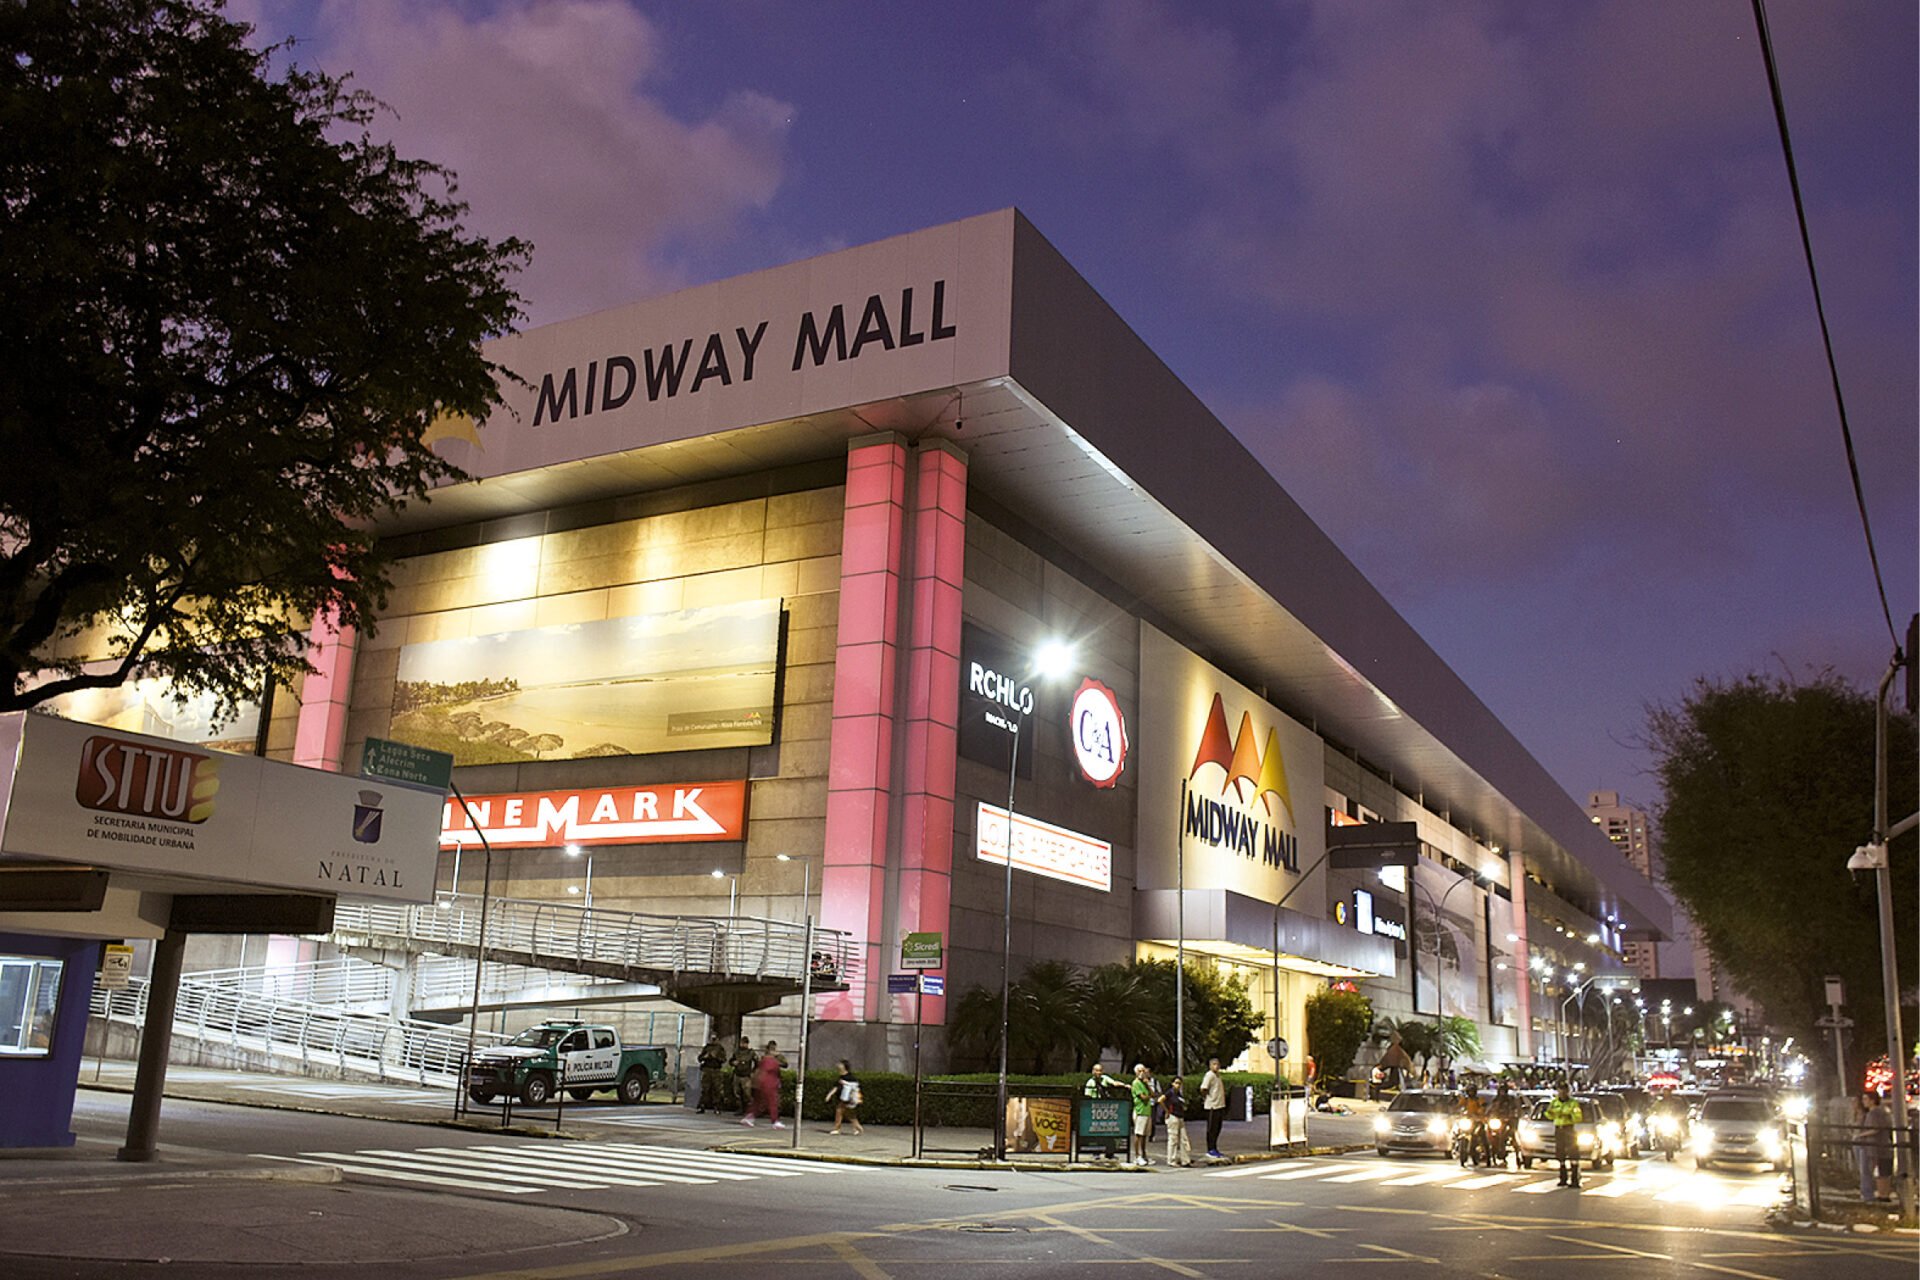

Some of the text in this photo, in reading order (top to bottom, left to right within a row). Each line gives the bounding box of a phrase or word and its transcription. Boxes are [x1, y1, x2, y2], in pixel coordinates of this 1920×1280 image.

[533, 280, 957, 427] MIDWAY MALL
[970, 661, 1034, 716] RCHLO
[1080, 709, 1115, 764] C&A
[380, 754, 416, 769] Alecrim
[411, 750, 431, 762] Seca
[96, 743, 192, 817] STTU
[377, 764, 428, 783] Zona Norte
[94, 815, 195, 838] SECRETARIA MUNICIPAL
[441, 788, 727, 842] INEMARK
[87, 828, 195, 850] DE MOBILIDADE URBANA
[1186, 789, 1301, 875] MIDWAY MALL
[318, 860, 403, 888] NATAL
[914, 941, 940, 951] Sicredi
[1091, 1108, 1119, 1120] 100%
